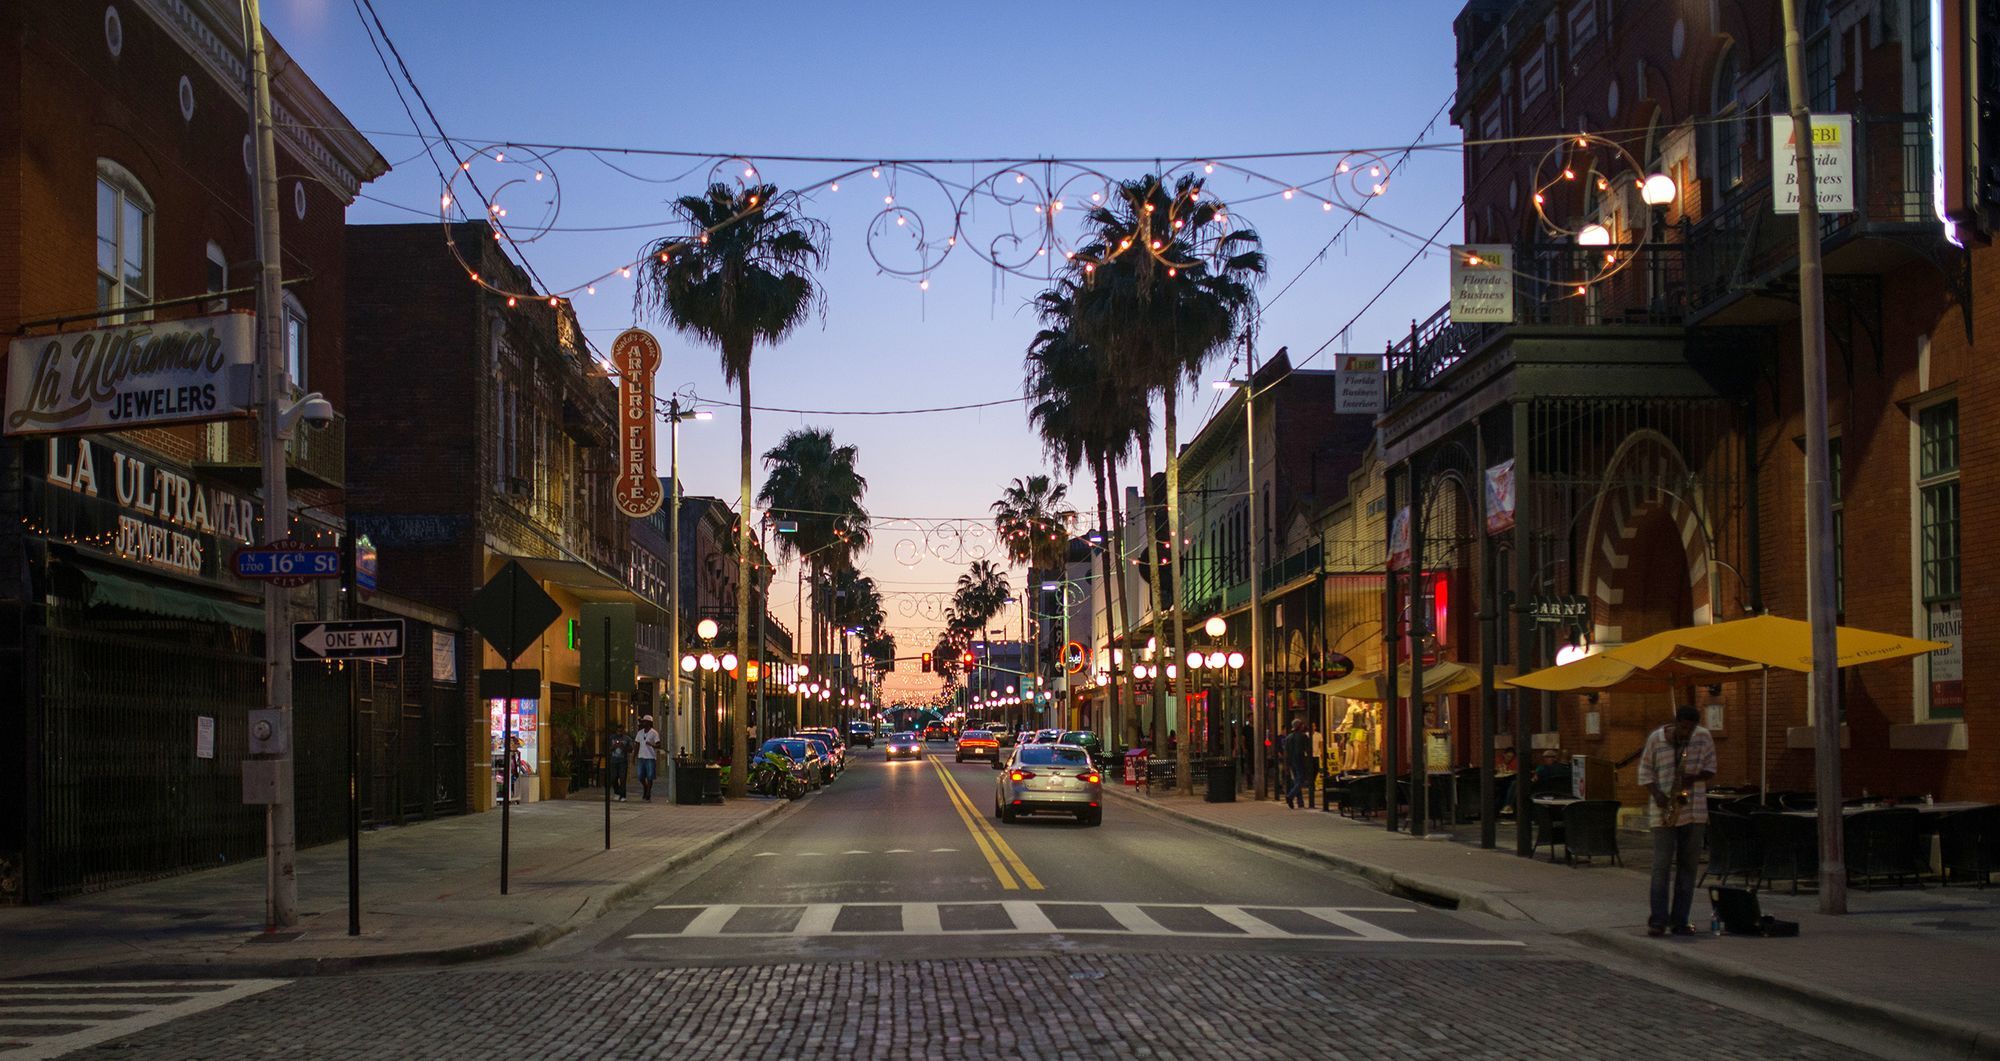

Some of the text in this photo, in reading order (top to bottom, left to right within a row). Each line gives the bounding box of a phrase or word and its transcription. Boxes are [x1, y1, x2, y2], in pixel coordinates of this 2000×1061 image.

[1786, 192, 1843, 203] Iniors
[1463, 275, 1501, 284] Florida
[1459, 290, 1505, 299] Business
[1459, 305, 1505, 315] Interiors
[9, 327, 224, 428] La Ultramar
[628, 345, 643, 420] ARTURO
[1342, 388, 1378, 397] Business
[109, 384, 216, 420] JEWELERS
[629, 425, 644, 499] FUENTE
[48, 437, 254, 546] LA ULTRAMAR
[618, 491, 659, 513] CIGARS
[115, 514, 202, 576] JEWELERS
[272, 540, 306, 551] YBOR
[247, 554, 256, 562] N
[269, 553, 336, 573] 16th St
[240, 562, 264, 572] 1700
[273, 576, 306, 585] CITY
[325, 631, 393, 647] ONE WAY
